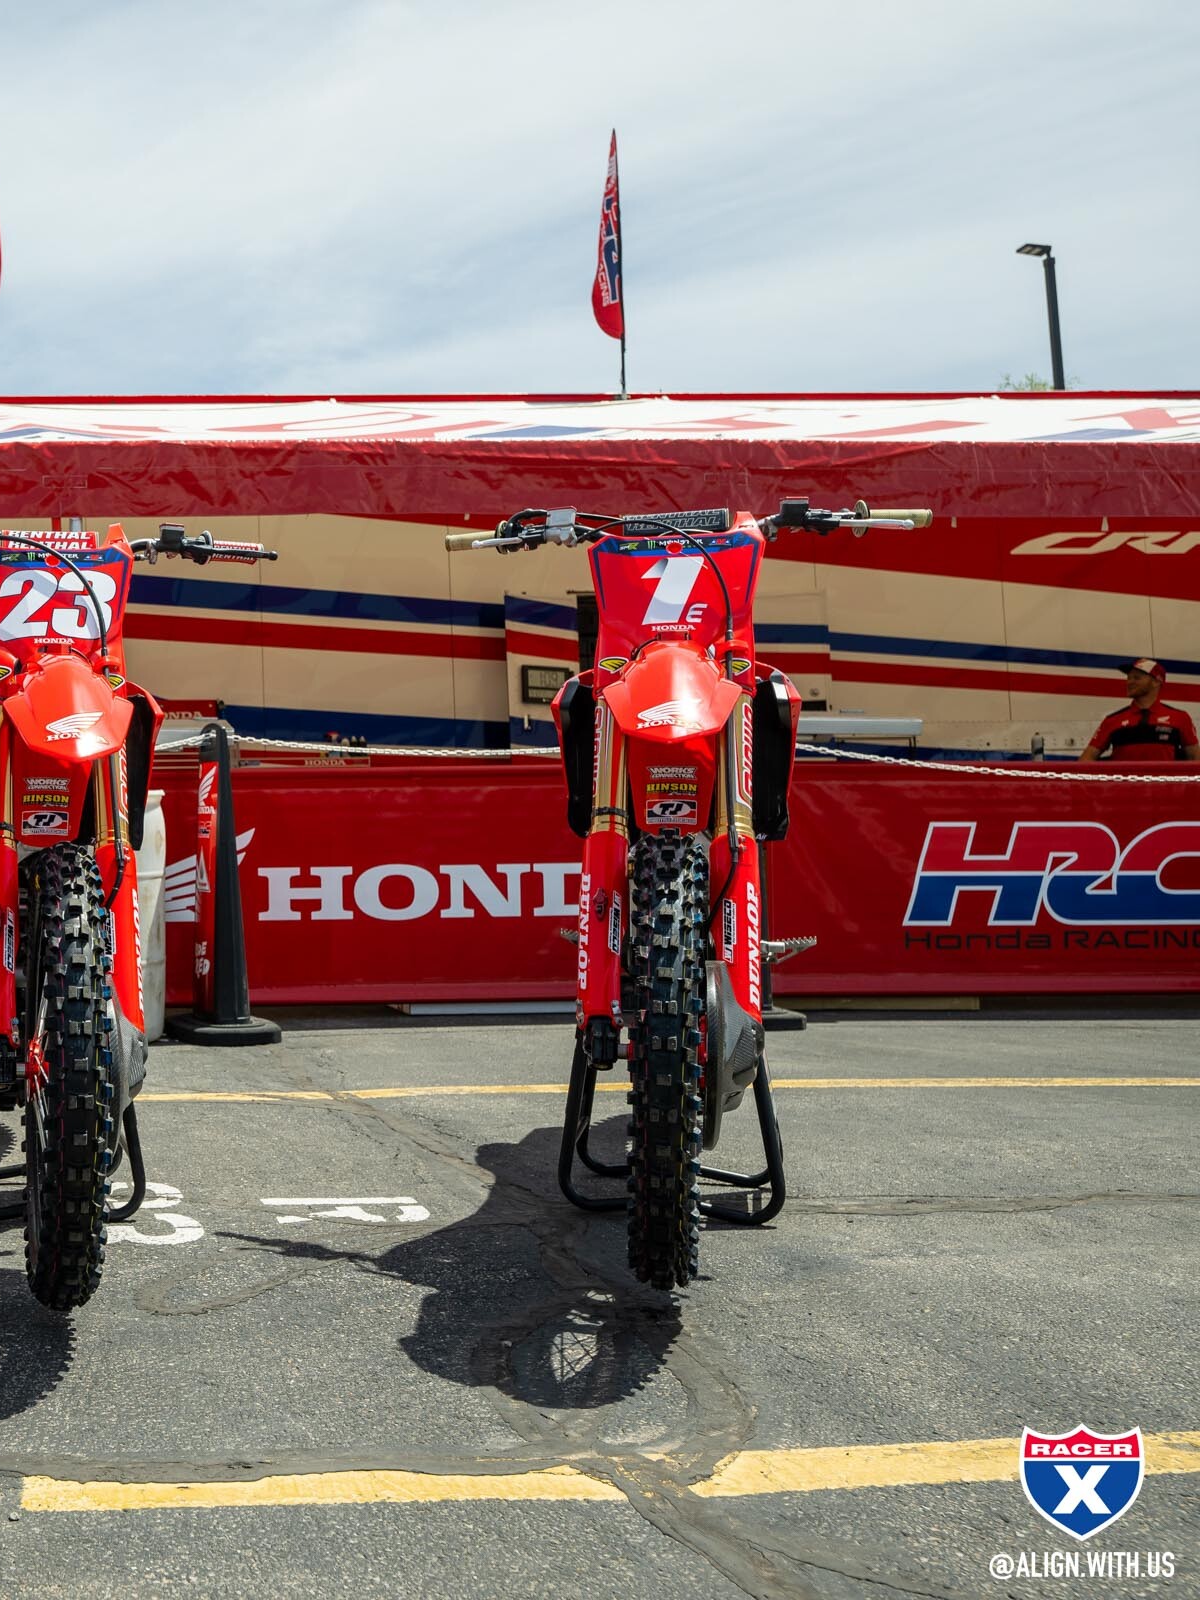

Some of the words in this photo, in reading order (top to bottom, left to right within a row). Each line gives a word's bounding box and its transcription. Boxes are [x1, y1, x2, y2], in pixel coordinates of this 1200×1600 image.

[641, 556, 705, 625] 1
[685, 603, 708, 623] E
[33, 637, 75, 645] HONDA
[162, 711, 203, 721] ONDA
[304, 758, 347, 767] HONDA
[649, 767, 698, 775] WORKS
[25, 778, 70, 786] WORKS
[646, 783, 697, 792] HINSON
[23, 794, 70, 803] HINSON
[578, 874, 591, 990] DUNLOP
[904, 928, 1052, 951] Honda
[132, 888, 144, 1013] DUNLOP
[746, 882, 761, 1011] DUNLOP
